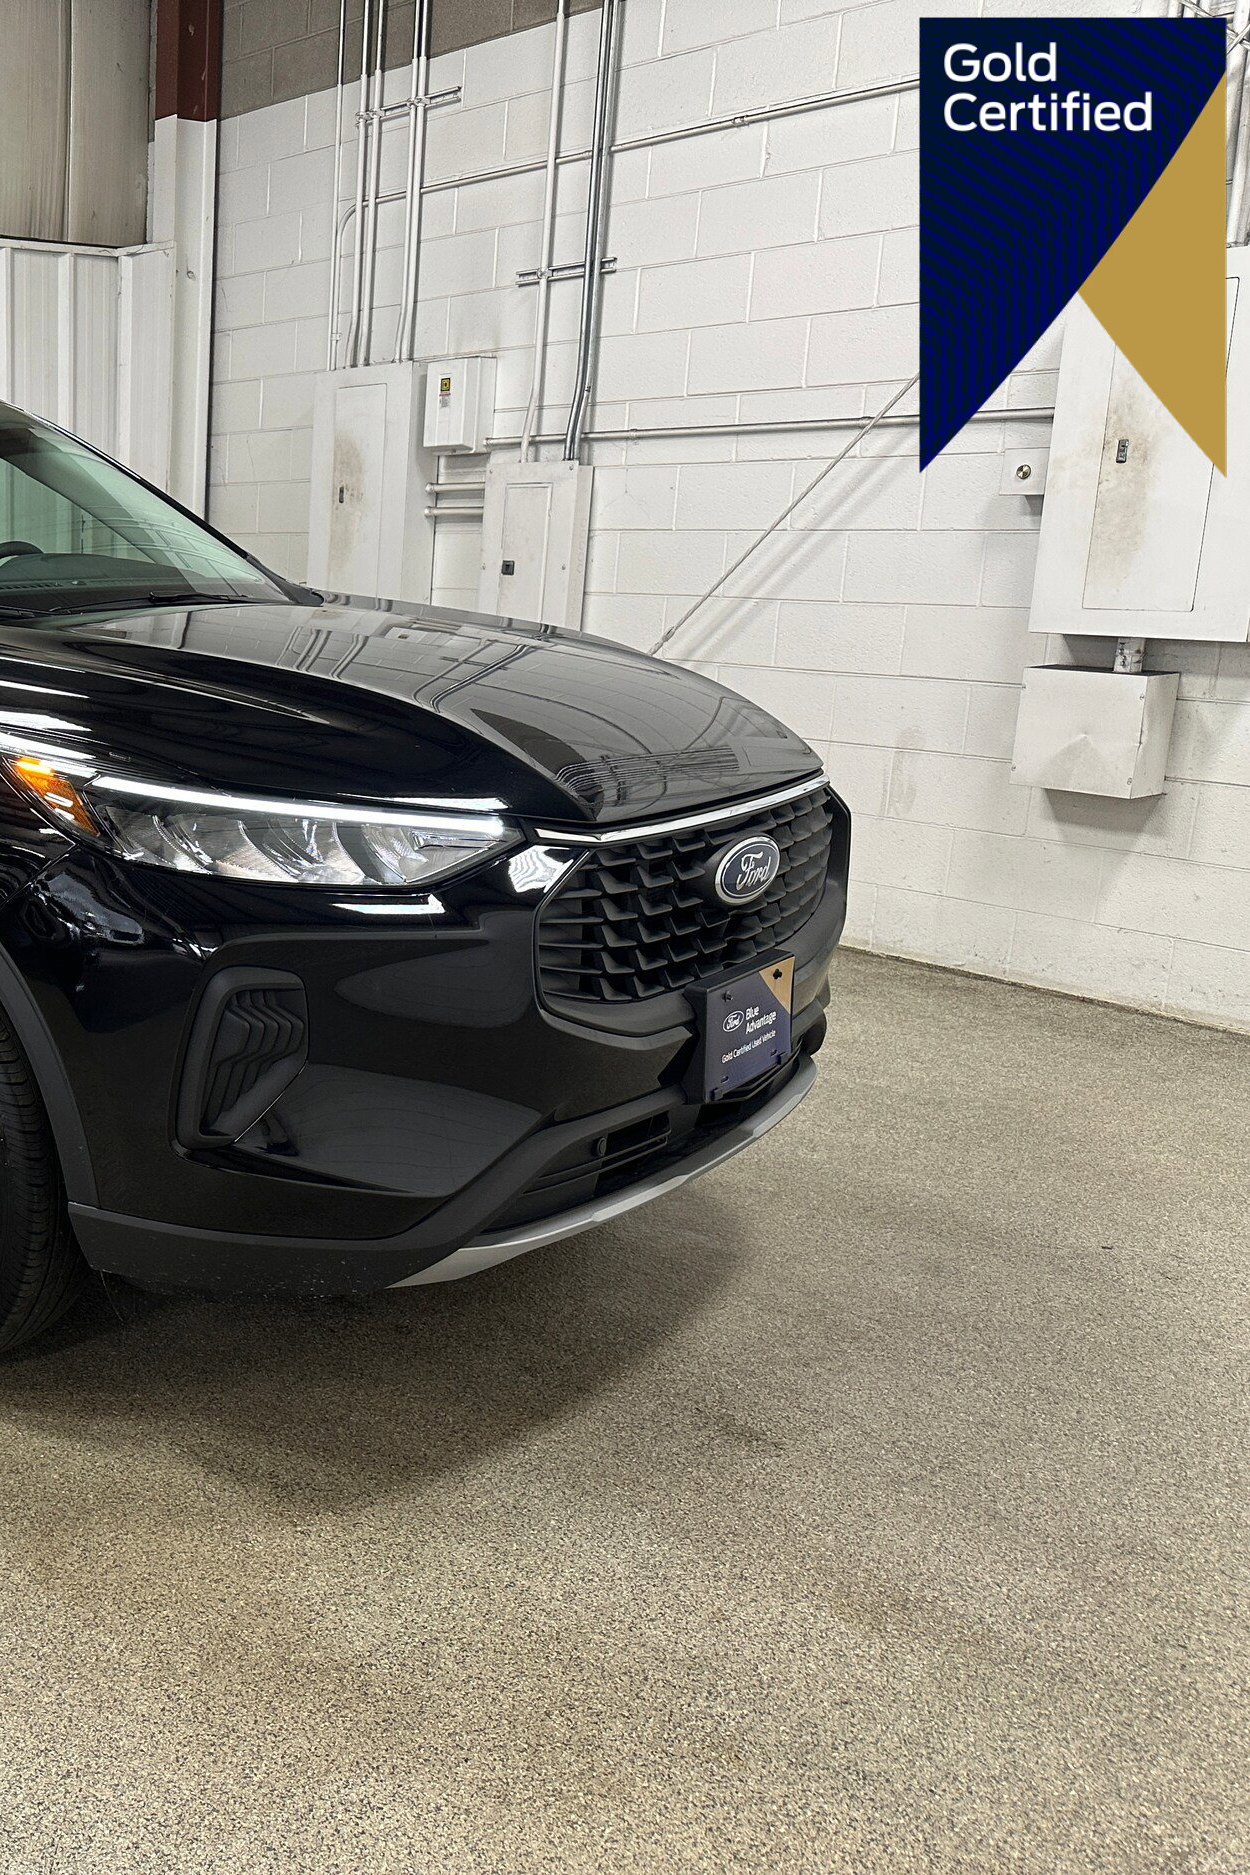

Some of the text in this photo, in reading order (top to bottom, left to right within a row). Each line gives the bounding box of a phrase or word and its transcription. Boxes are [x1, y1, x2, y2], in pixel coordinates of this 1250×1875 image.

[735, 851, 772, 891] Ford
[726, 1013, 741, 1030] Ford
[745, 1006, 760, 1021] Blue
[745, 1011, 777, 1035] Advantage
[721, 1030, 777, 1064] Gold Certified Used Vehicle
